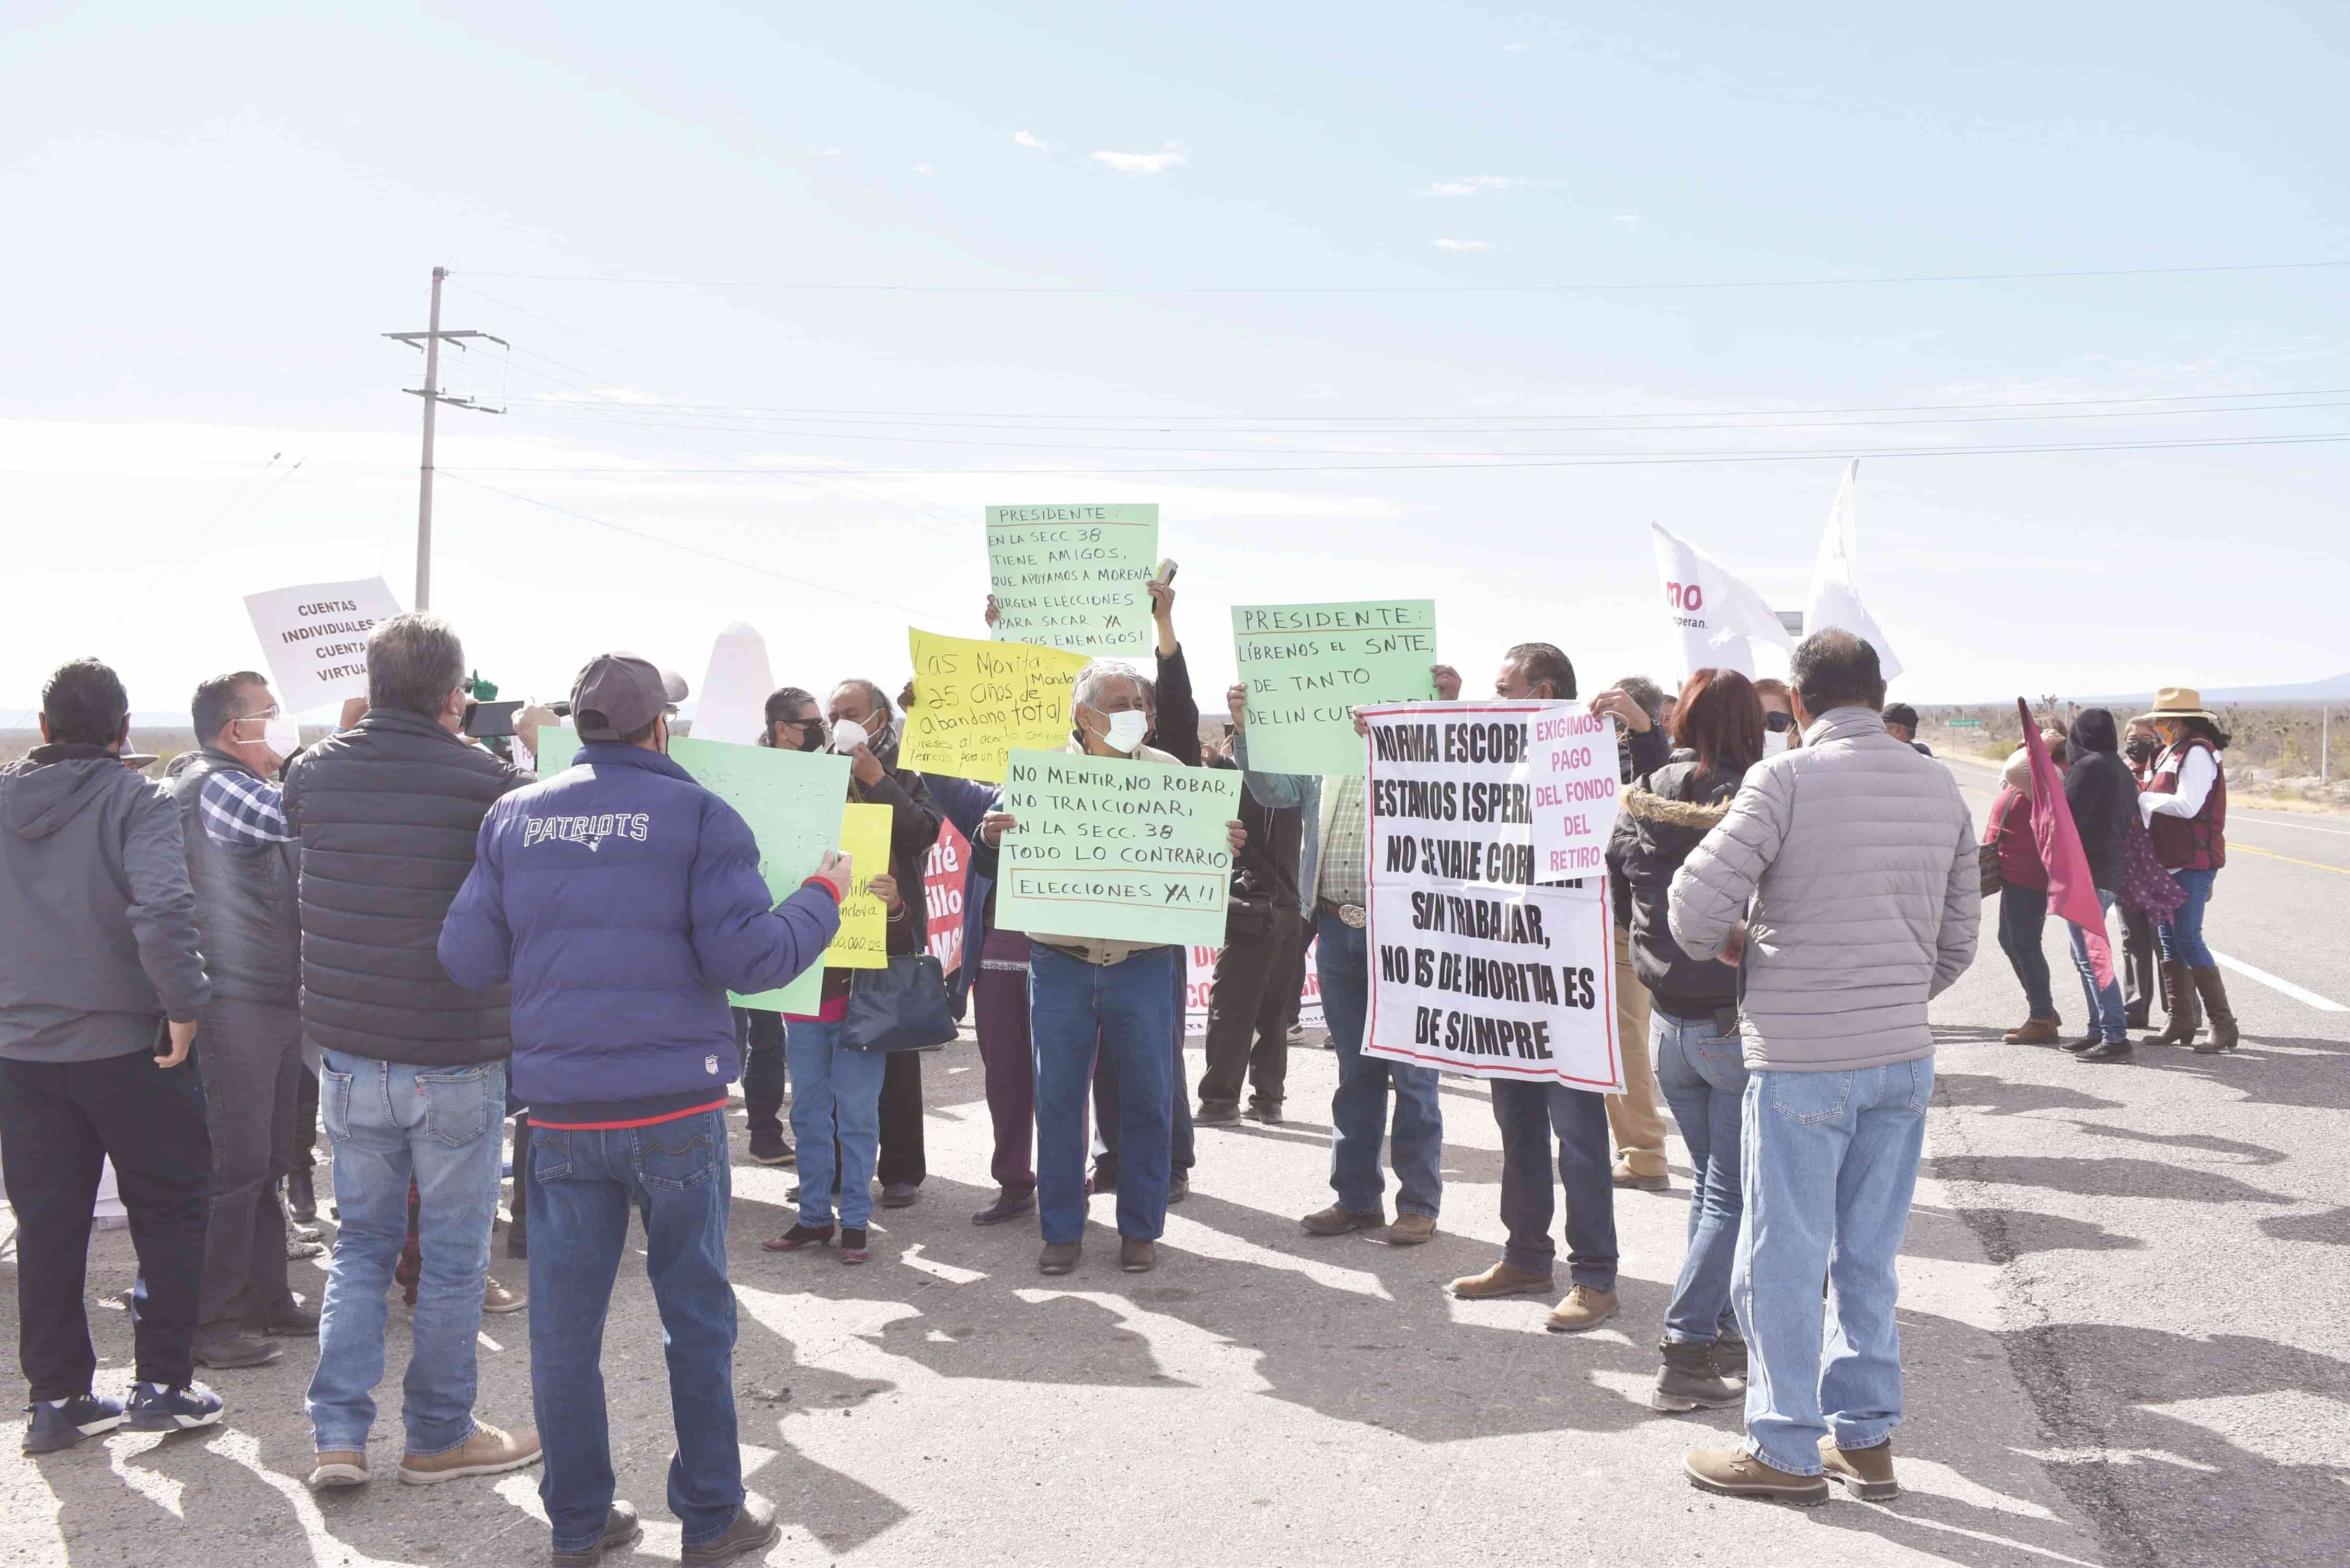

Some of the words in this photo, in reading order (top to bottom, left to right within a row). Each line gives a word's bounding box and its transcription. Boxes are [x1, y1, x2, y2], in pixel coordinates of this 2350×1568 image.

[989, 535, 1004, 547] EN
[1010, 535, 1024, 544] LA
[1078, 528, 1101, 542] 38
[991, 555, 1038, 566] TIENE
[1049, 548, 1126, 563] AMIGOS,
[991, 576, 1017, 587] QUE
[1022, 570, 1078, 585] APOYAMOS
[1083, 570, 1090, 581] A
[1098, 566, 1153, 581] MORENA
[298, 600, 356, 616] CUENTAS
[996, 597, 1037, 609] URGEN
[1044, 594, 1134, 608] ELECCIONES
[999, 618, 1033, 629] PARA
[1042, 615, 1091, 627] SACAR
[1102, 615, 1122, 629] YA
[1243, 608, 1422, 630] PRESIDENTE:
[282, 619, 375, 643] INDIVIDUALES
[1055, 630, 1144, 646] ENEMIGOS!
[316, 641, 367, 659] CUENTA
[915, 640, 959, 676] Las
[1239, 641, 1319, 662] LÍBRENOS
[1331, 641, 1346, 652] EL
[1031, 670, 1076, 686] Monclo
[1253, 678, 1278, 693] DE
[1289, 668, 1370, 691] TANTO
[929, 685, 960, 709] 25
[1020, 675, 1044, 702] de
[920, 704, 1006, 734] abandono
[1011, 696, 1061, 726] total
[1537, 713, 1603, 741] EXIGIMOS
[960, 732, 972, 748] al
[1372, 724, 1439, 762] NORMA
[981, 752, 993, 762] un
[1552, 747, 1591, 771] PAGO
[1013, 765, 1036, 782] NO
[1048, 766, 1122, 791] MENTIR,
[1126, 776, 1150, 791] NO
[1164, 775, 1234, 797] ROBAR,
[1536, 785, 1562, 807] DEL
[1565, 777, 1615, 803] FONDO
[1012, 793, 1037, 808] NO
[1045, 795, 1193, 817] TRAICIONAR,
[1373, 779, 1457, 821] ESTAMOS
[524, 813, 649, 847] PATRIOTS
[1043, 821, 1066, 835] LA
[1077, 823, 1136, 839] SECC.
[1145, 823, 1173, 839] 38
[1564, 814, 1591, 836] DEL
[1004, 845, 1061, 860] TODO
[1076, 846, 1106, 860] LO
[1121, 847, 1228, 868] CONTRARIO
[1386, 835, 1416, 873] NO
[1550, 846, 1600, 871] RETIRO
[1020, 879, 1153, 898] ELECCIONES
[838, 903, 878, 918] nclova
[1411, 891, 1445, 932] SIN
[1381, 944, 1409, 984] NO
[1438, 951, 1462, 993] DE
[1563, 966, 1595, 1010] ES
[1415, 1006, 1443, 1047] DE
